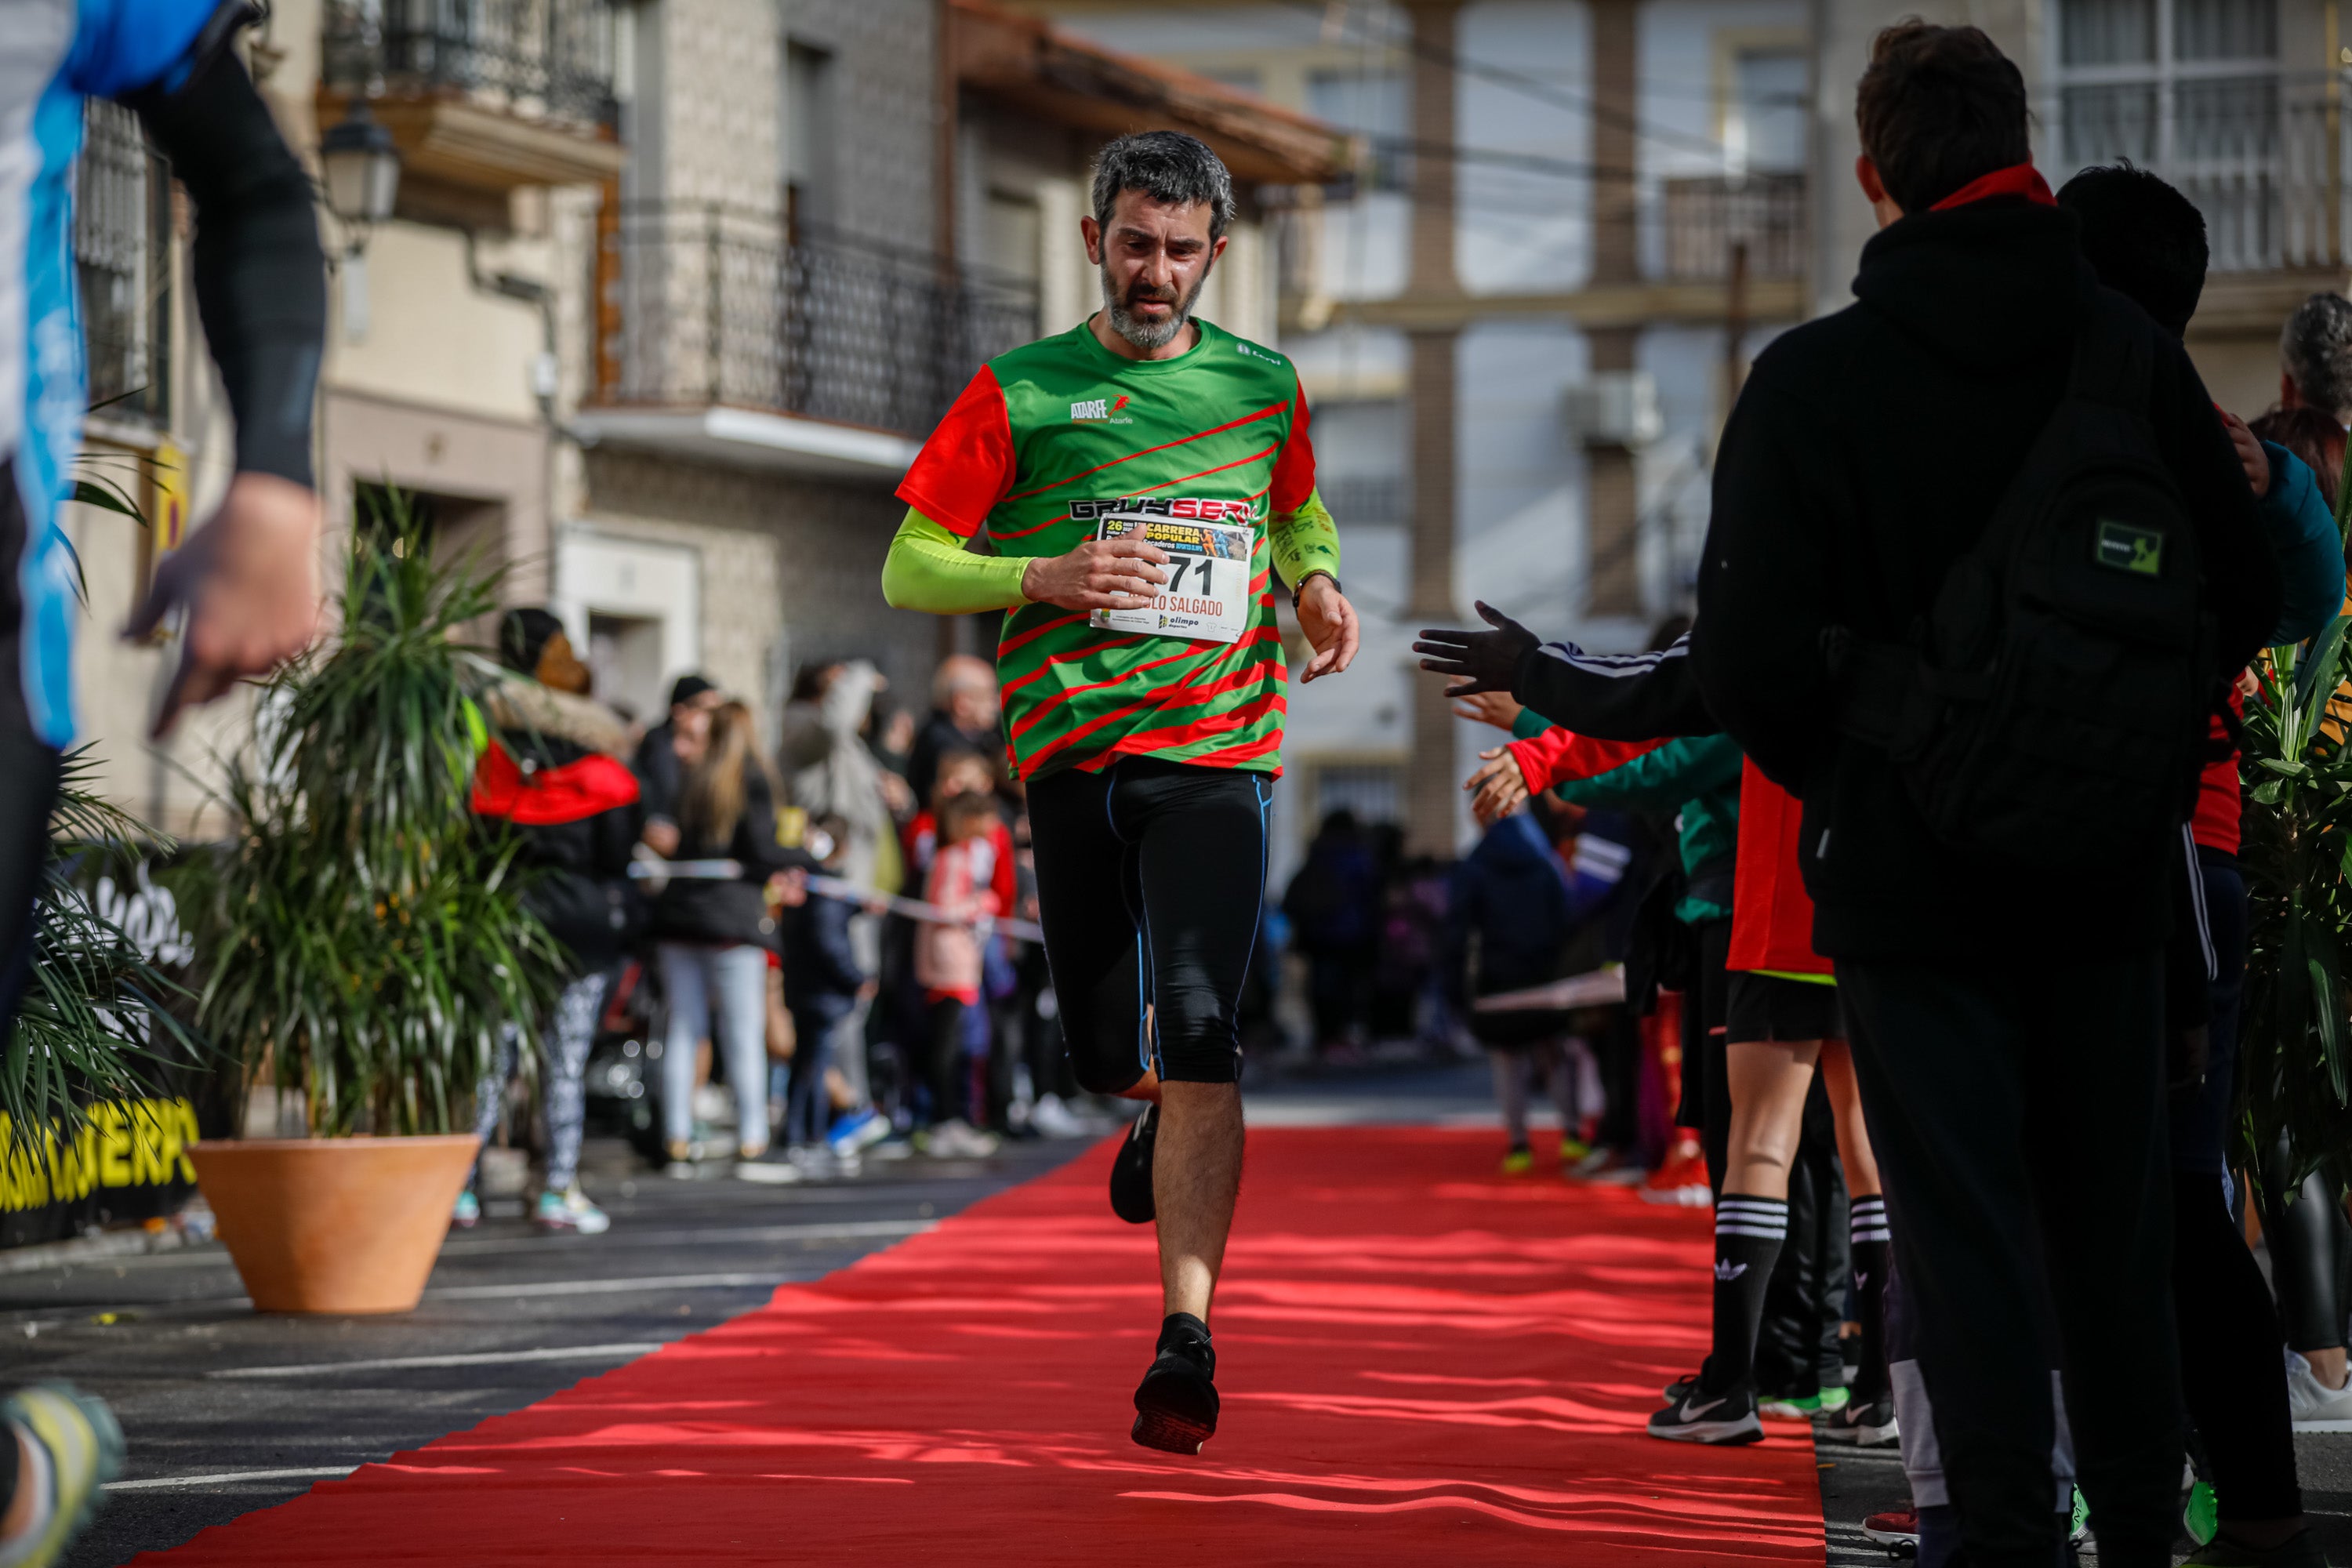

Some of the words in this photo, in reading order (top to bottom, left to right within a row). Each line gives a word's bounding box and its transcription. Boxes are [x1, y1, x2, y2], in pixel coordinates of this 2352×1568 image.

[1071, 399, 1108, 419] ATARFE
[1107, 520, 1123, 532] 26
[1147, 523, 1200, 537] CARRERA
[1142, 539, 1175, 549] Secaderos
[1145, 532, 1200, 544] POPULAR
[1169, 596, 1222, 616] SALGADO
[1170, 616, 1199, 626] olimpo
